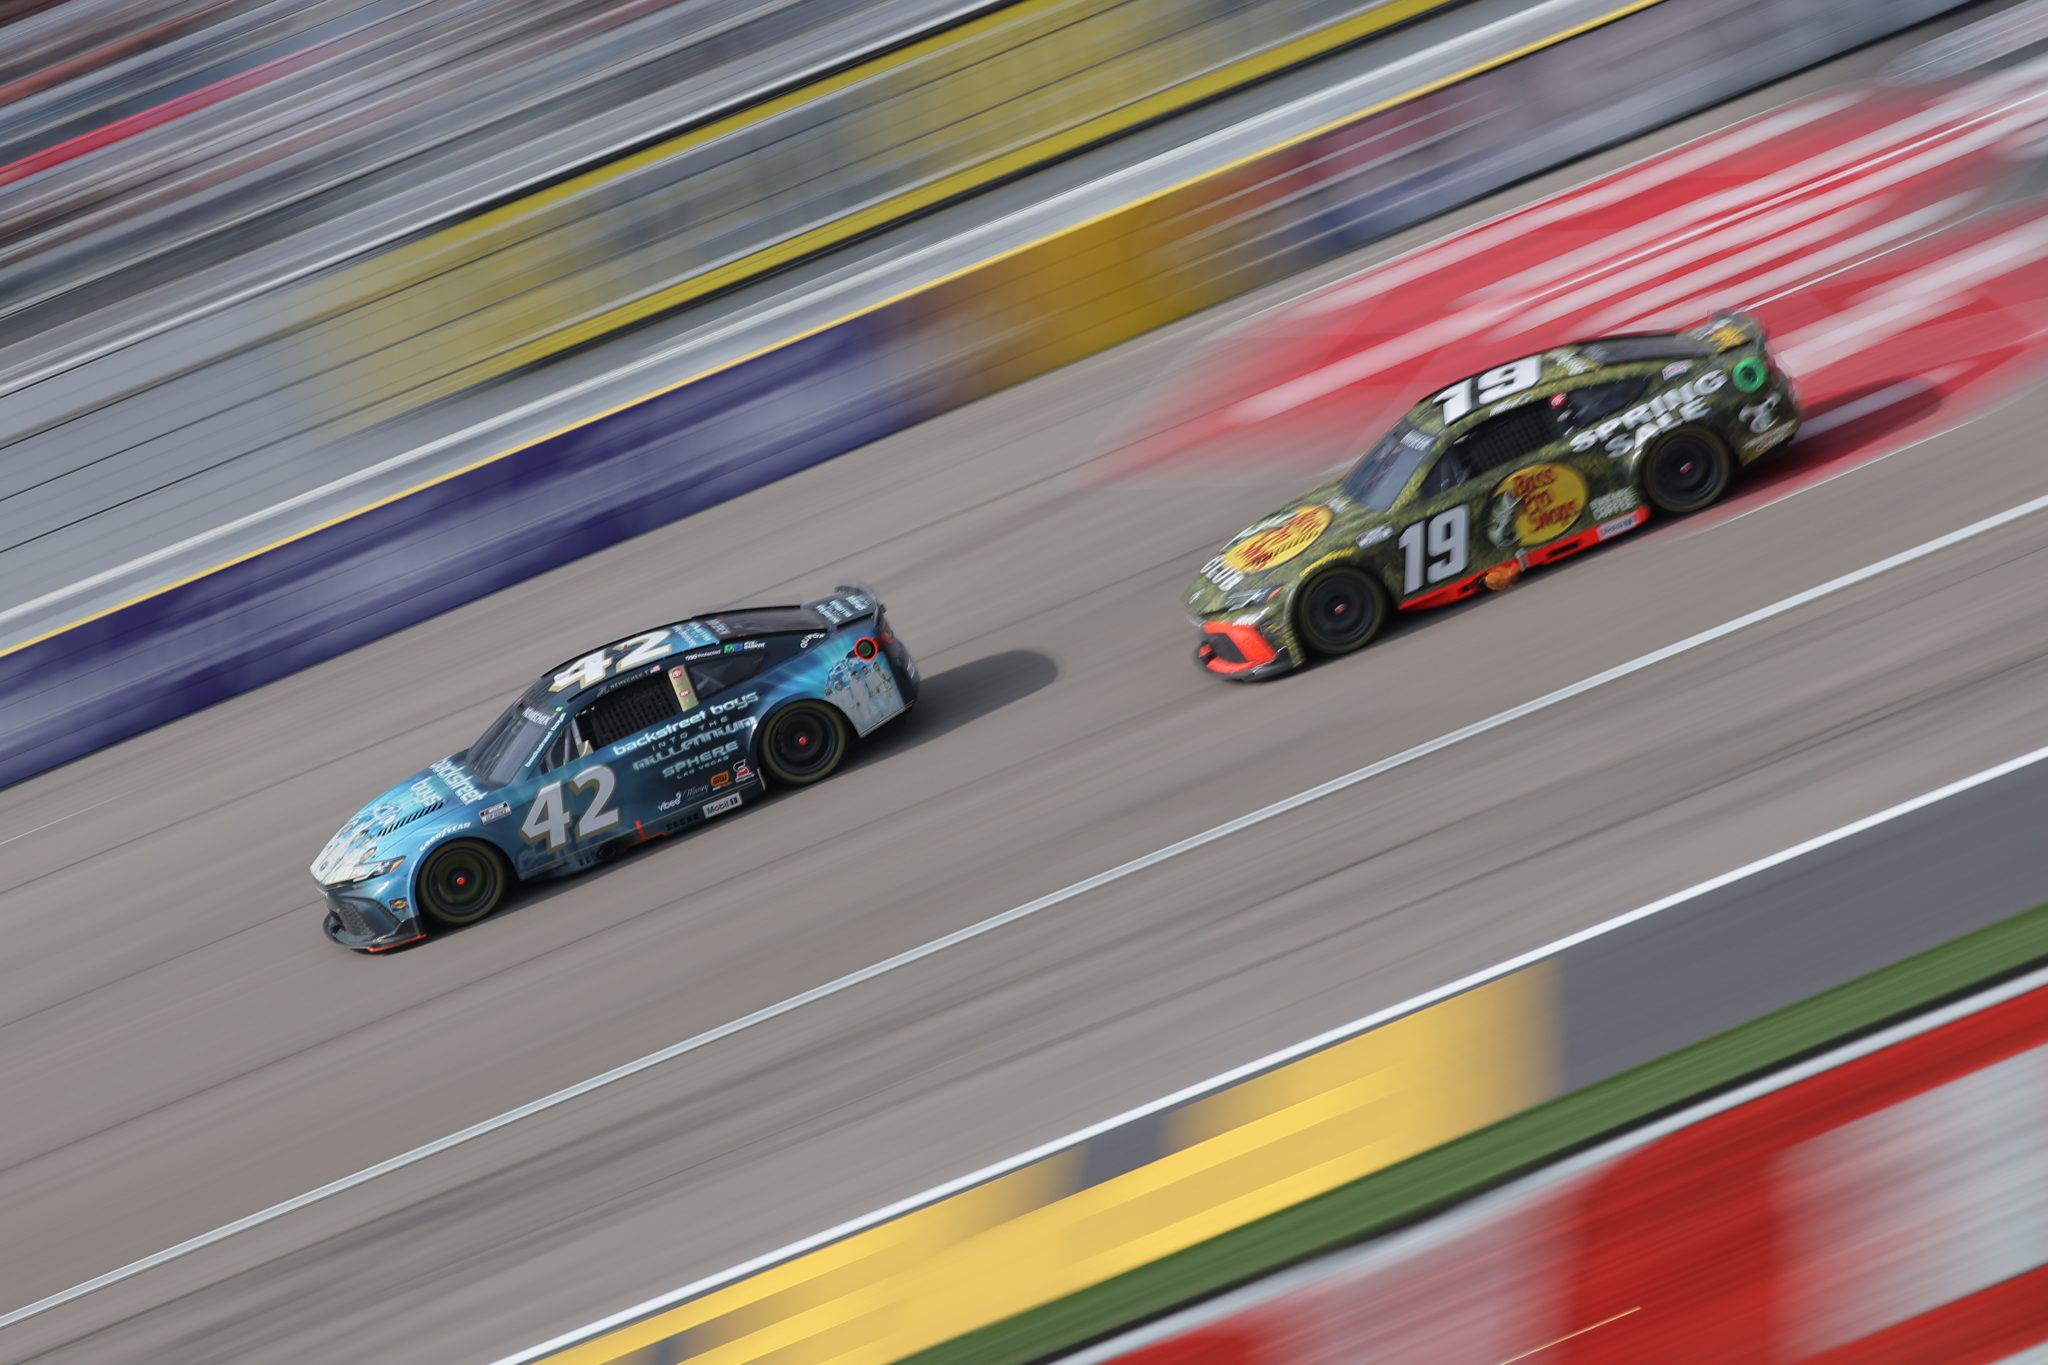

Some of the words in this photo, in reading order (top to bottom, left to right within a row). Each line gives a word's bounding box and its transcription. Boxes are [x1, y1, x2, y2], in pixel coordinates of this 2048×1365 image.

[1432, 354, 1542, 426] 19
[1568, 369, 1729, 453] SPRING
[1604, 395, 1712, 459] SALE
[1512, 467, 1557, 497] Bass
[1397, 503, 1471, 596] 19
[548, 629, 673, 693] 42
[613, 710, 706, 756] backstreet
[710, 691, 760, 715] boys
[631, 715, 758, 772] MILLENNIUM
[651, 731, 688, 751] INTO
[698, 715, 729, 732] THE
[430, 755, 488, 806] backstreet
[662, 740, 739, 778] SPHERE
[676, 770, 695, 780] LAS
[699, 755, 730, 771] VEGAS
[410, 776, 444, 806] boys
[519, 764, 620, 851] 42
[706, 799, 730, 815] Mobil
[418, 821, 472, 853] GOODYEAR
